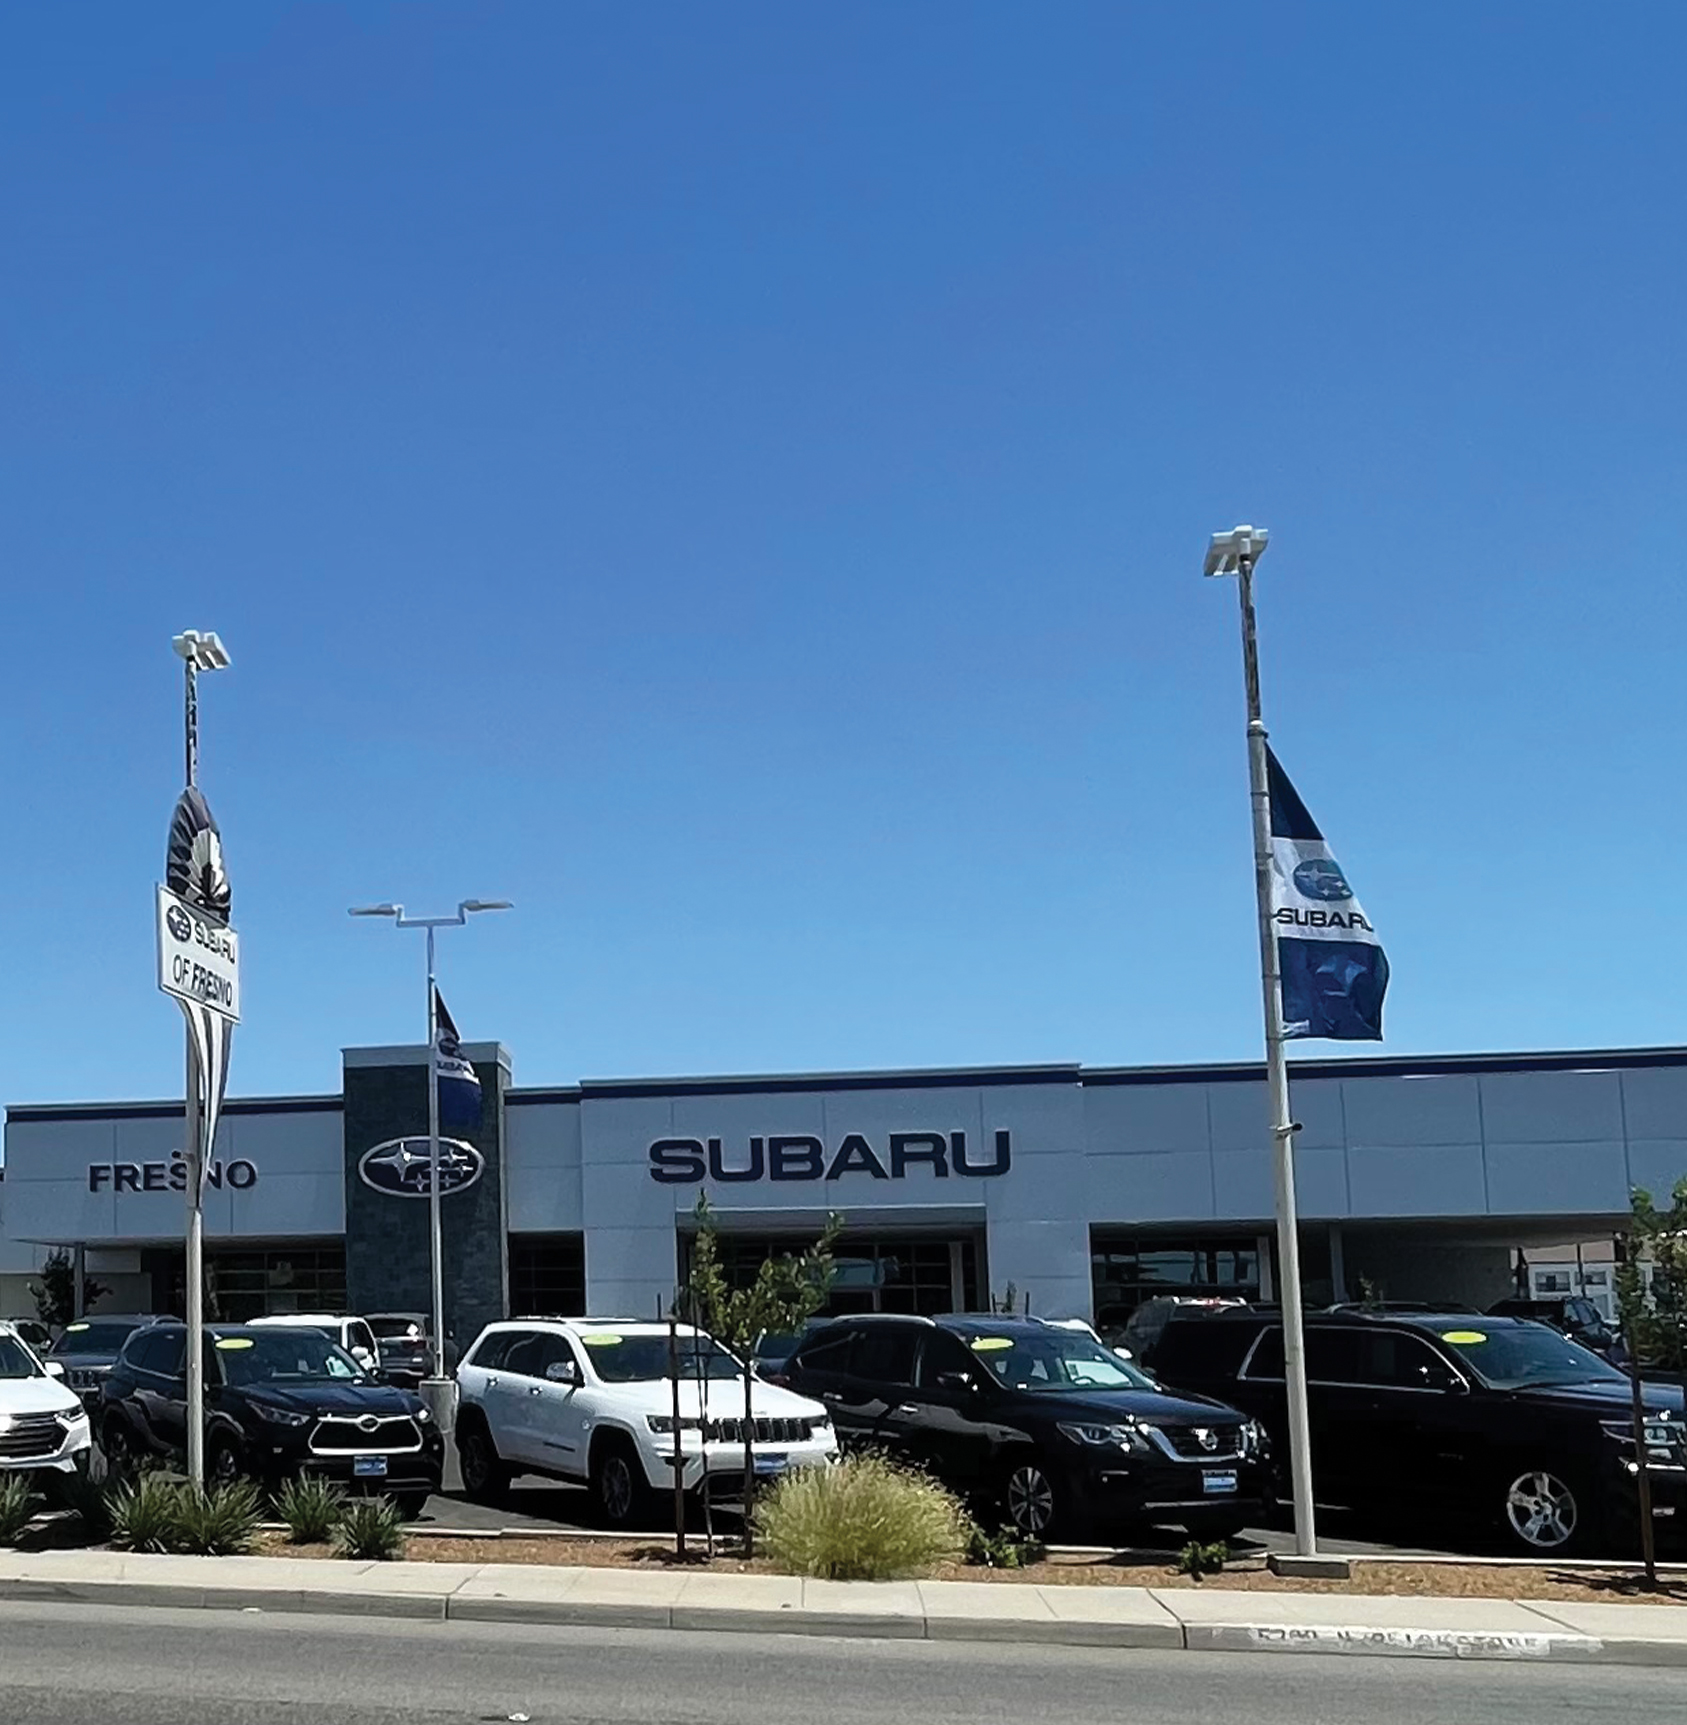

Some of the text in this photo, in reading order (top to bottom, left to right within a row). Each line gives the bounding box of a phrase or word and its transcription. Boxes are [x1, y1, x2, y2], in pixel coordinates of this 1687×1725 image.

[173, 954, 233, 1008] OF FRESNO
[649, 1130, 1011, 1183] SUBARU
